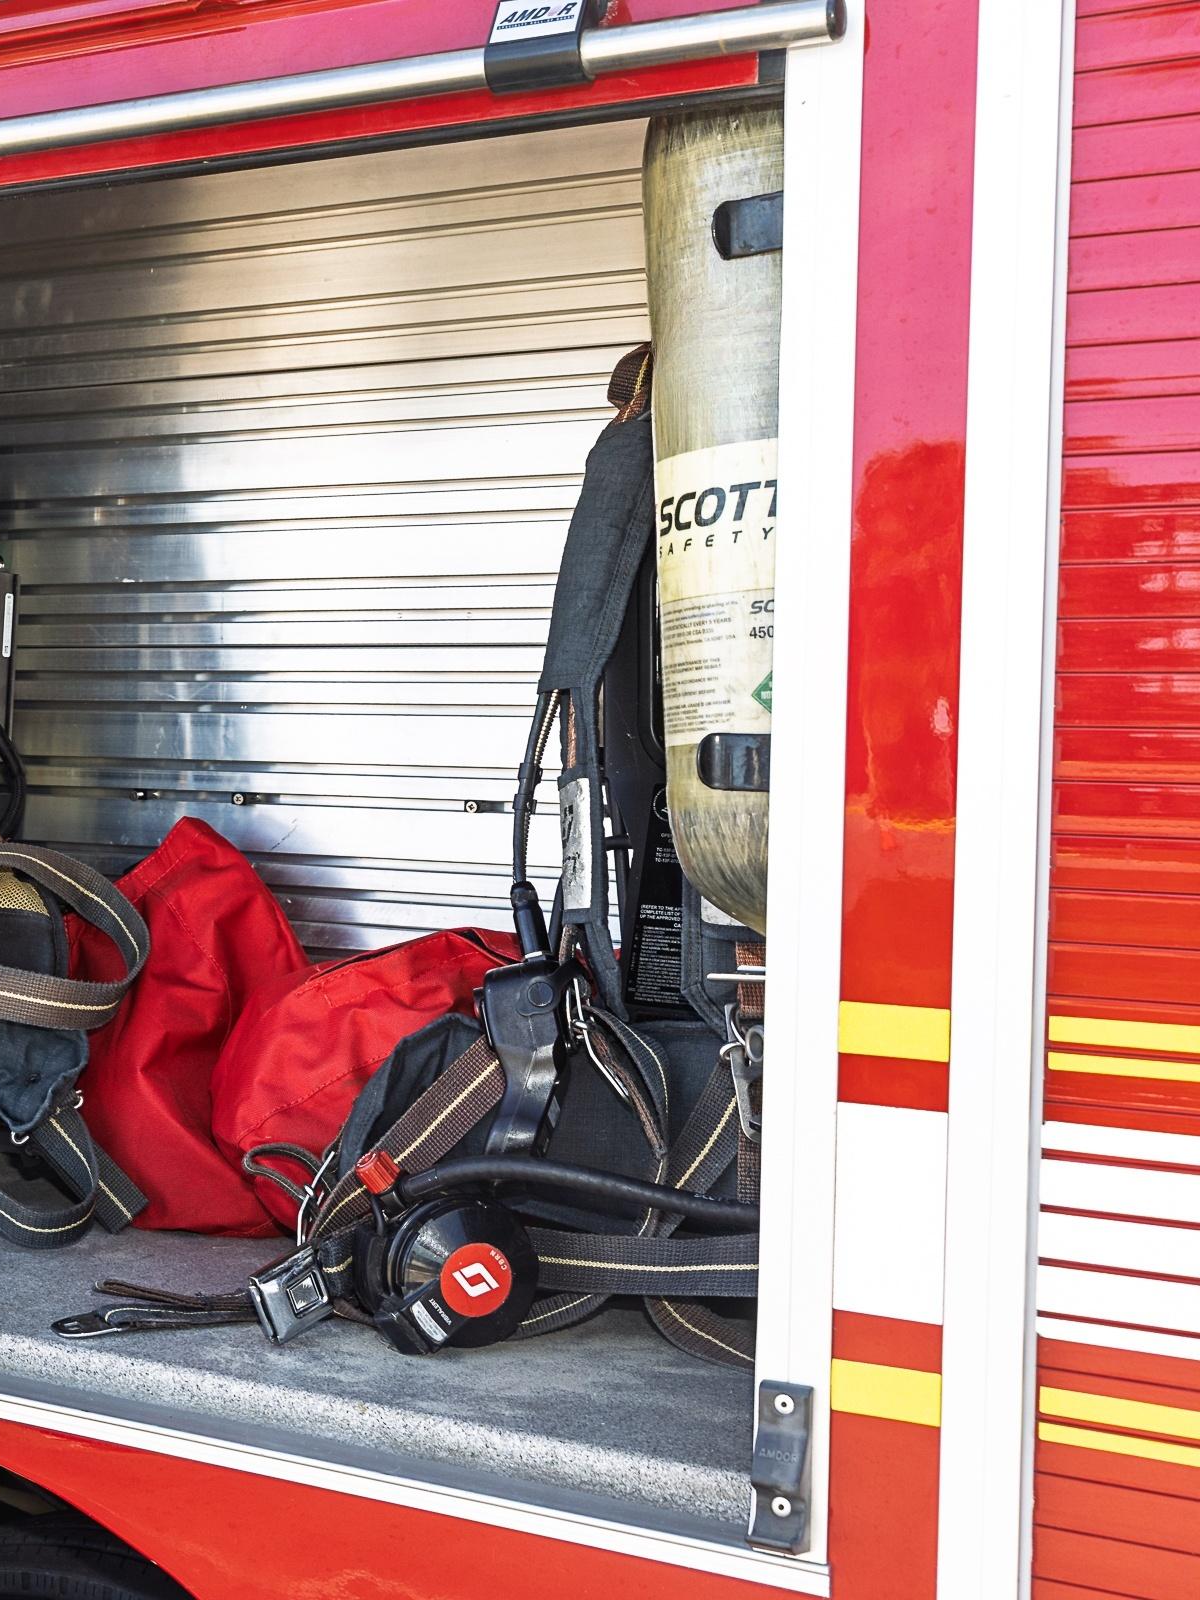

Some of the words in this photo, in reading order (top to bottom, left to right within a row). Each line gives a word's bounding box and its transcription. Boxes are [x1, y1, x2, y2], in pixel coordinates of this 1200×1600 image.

[500, 2, 577, 24] AMDR
[490, 1250, 507, 1270] CBRN
[428, 1298, 452, 1326] VIBRALERT
[758, 1448, 799, 1463] AMDOR
